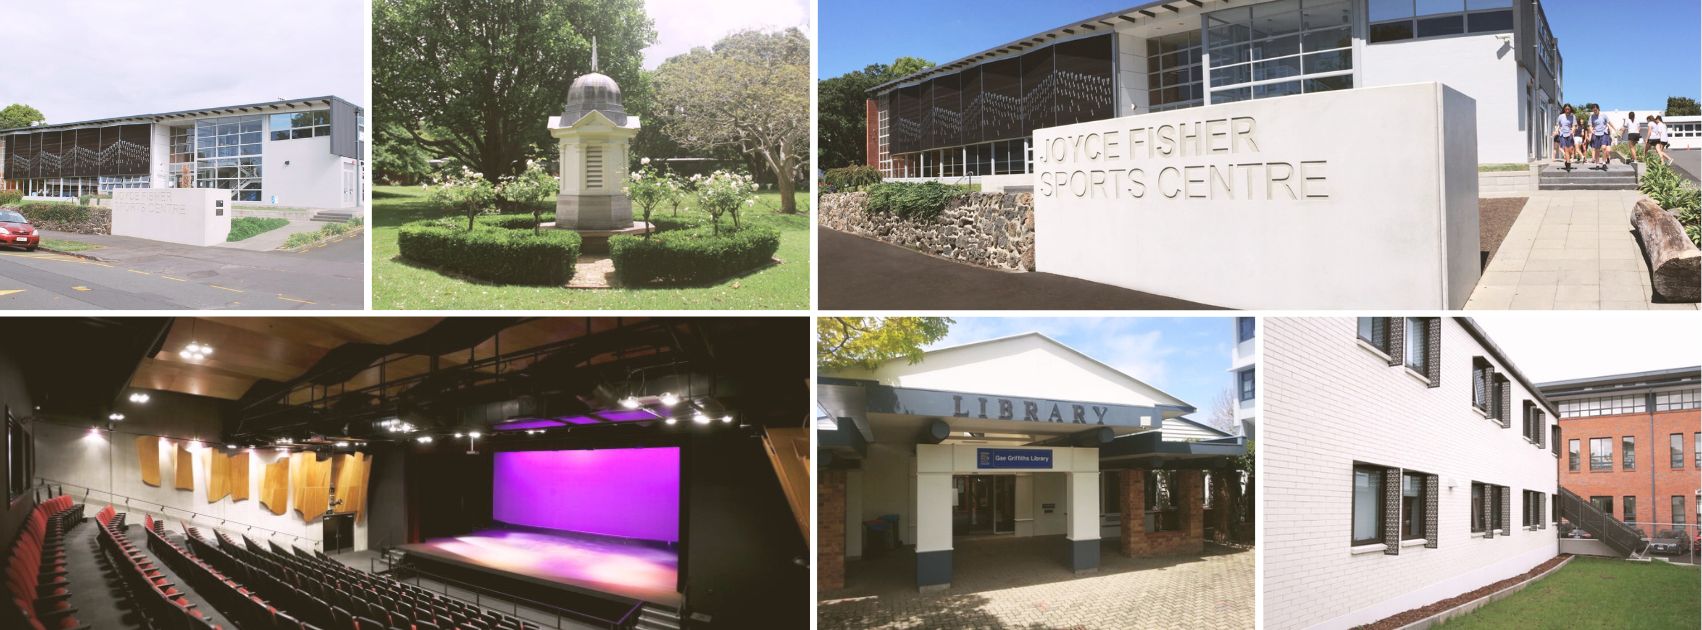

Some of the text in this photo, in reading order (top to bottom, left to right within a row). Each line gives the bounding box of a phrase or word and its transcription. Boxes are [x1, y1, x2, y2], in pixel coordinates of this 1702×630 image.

[1040, 115, 1261, 164] JOYCE FISHER
[1040, 160, 1329, 201] SPORTS CENTRE
[952, 395, 1109, 425] LIBRARY
[1030, 455, 1049, 463] Library
